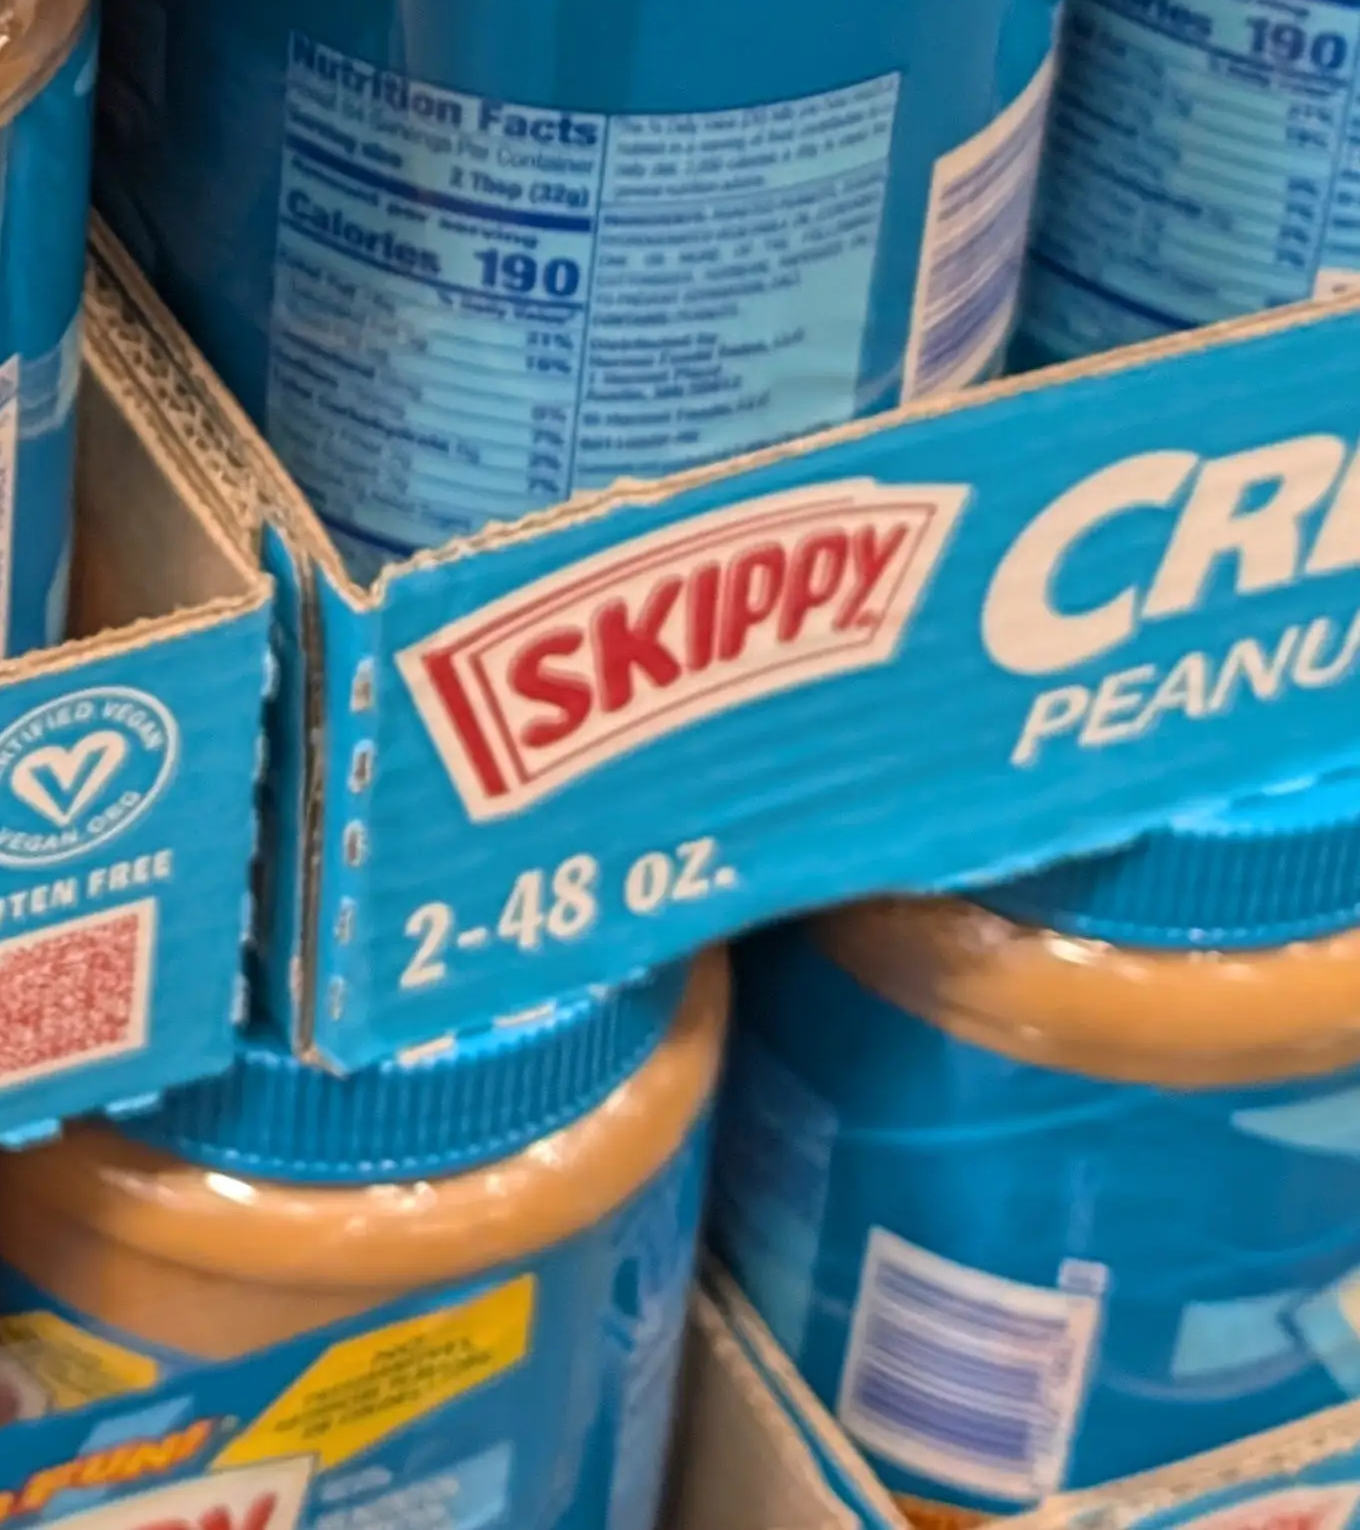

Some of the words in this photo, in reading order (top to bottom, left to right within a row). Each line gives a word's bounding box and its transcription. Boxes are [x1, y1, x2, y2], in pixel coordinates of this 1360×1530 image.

[1247, 17, 1347, 72] 190
[482, 100, 598, 149] Facts
[474, 247, 581, 298] 190
[505, 523, 910, 749] SKIPPY
[1011, 608, 1360, 768] PEANU
[102, 701, 163, 751] VEGAN
[86, 849, 173, 899] FREE
[400, 853, 598, 990] 2-48
[625, 838, 736, 914] oz.
